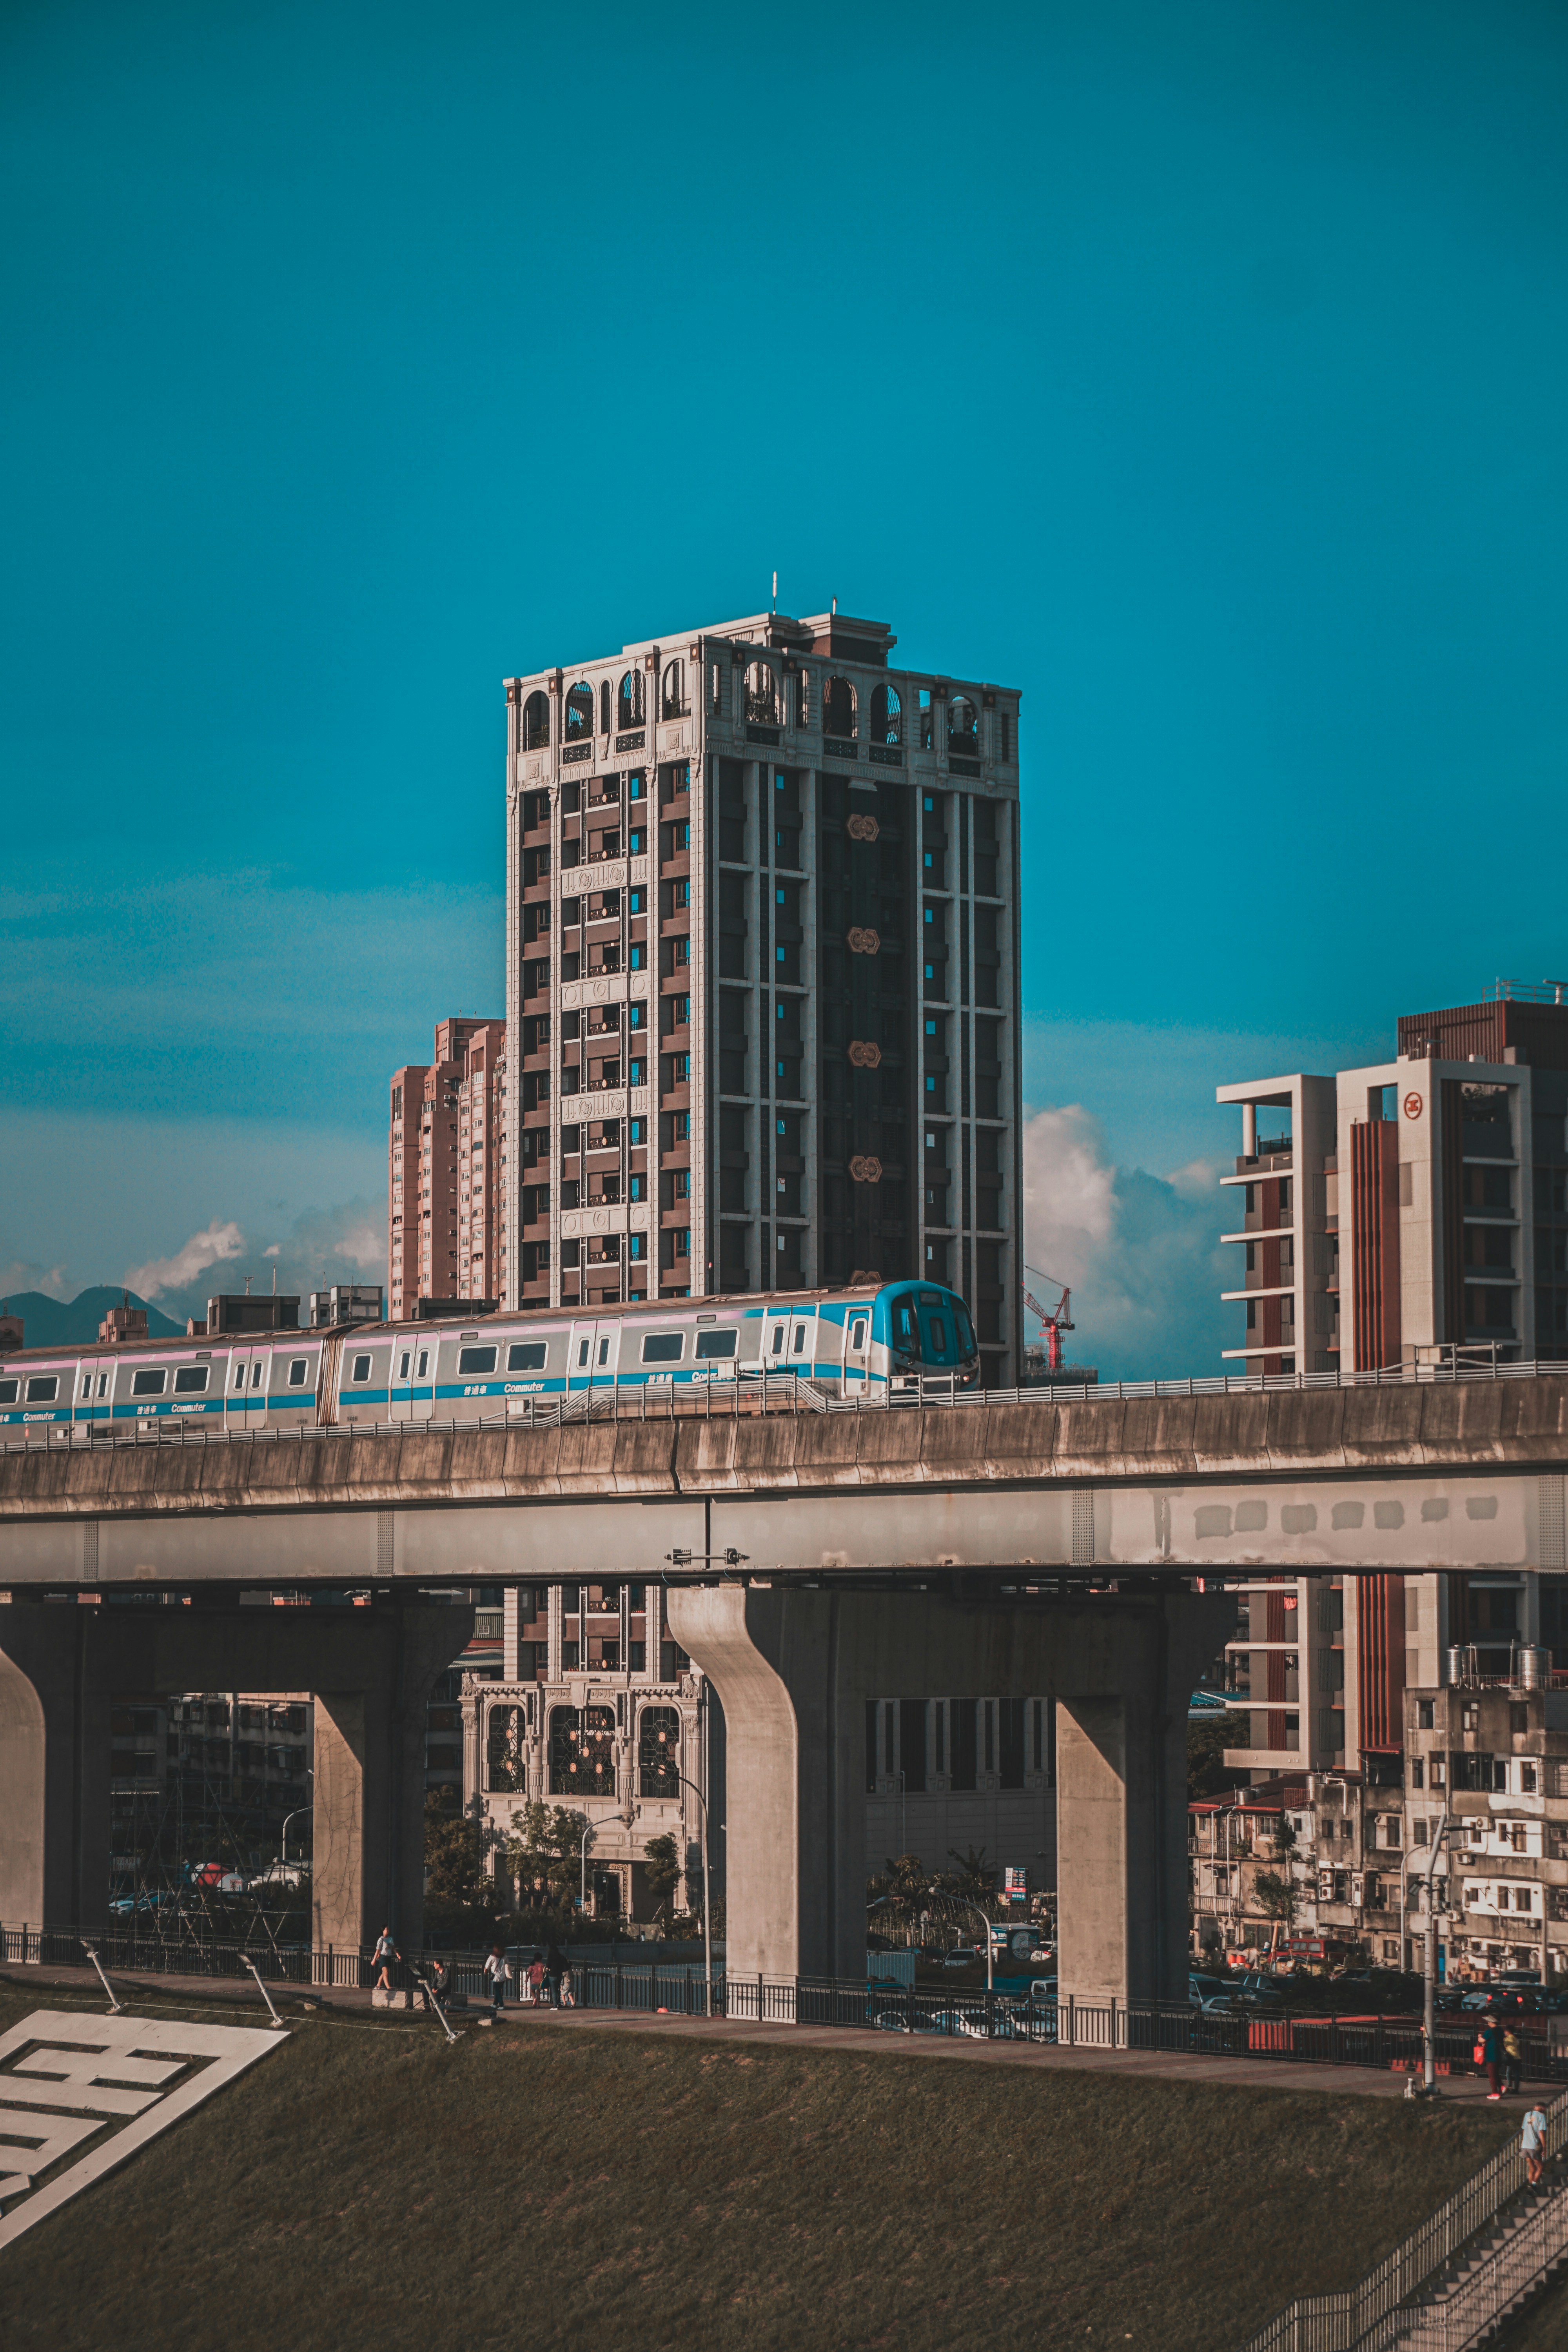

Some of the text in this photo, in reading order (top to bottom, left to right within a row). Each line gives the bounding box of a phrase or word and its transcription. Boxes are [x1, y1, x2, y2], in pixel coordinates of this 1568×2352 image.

[464, 1385, 487, 1395] 普通車
[504, 1382, 544, 1393] Commuter
[137, 1405, 157, 1415] 普通車
[171, 1403, 206, 1412] Commuter
[23, 1412, 56, 1421] Commuter
